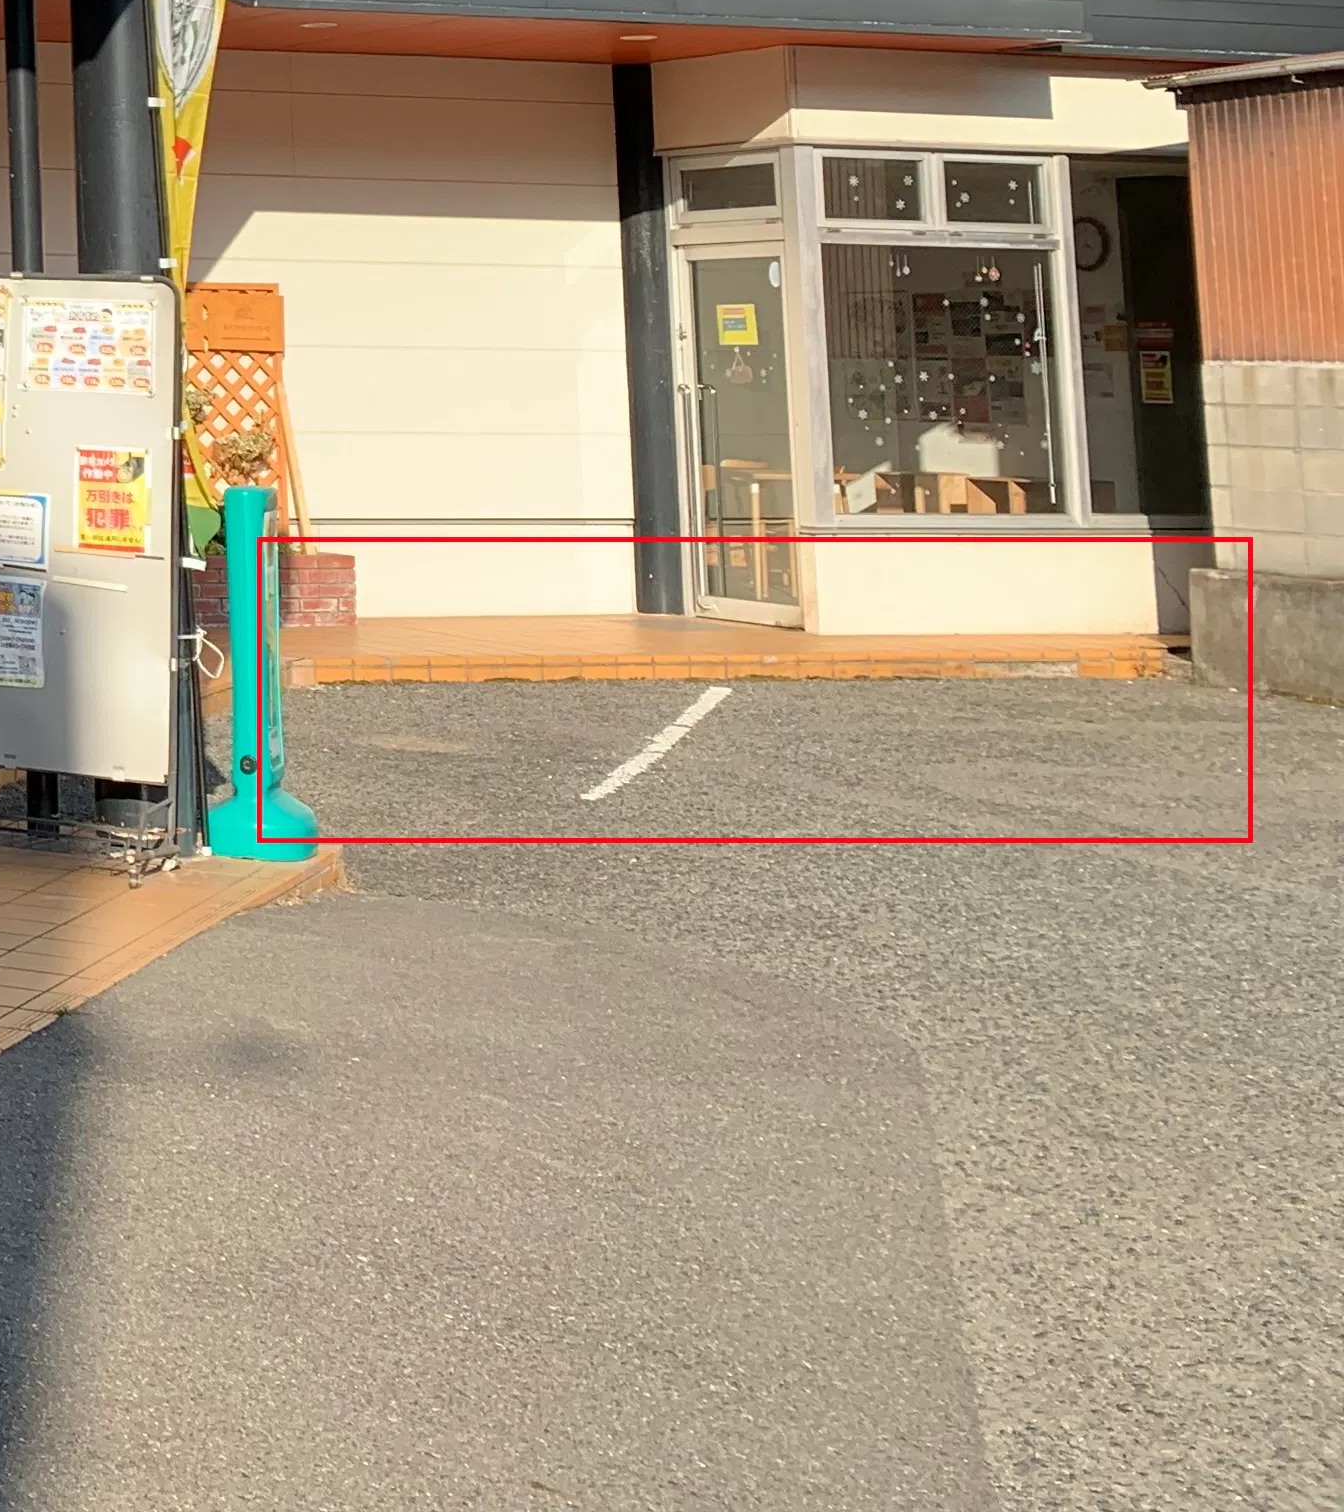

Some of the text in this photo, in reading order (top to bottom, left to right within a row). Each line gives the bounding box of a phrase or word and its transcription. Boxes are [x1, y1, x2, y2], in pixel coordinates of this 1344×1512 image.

[85, 489, 136, 505] 万引きは
[85, 507, 131, 530] 犯罪
